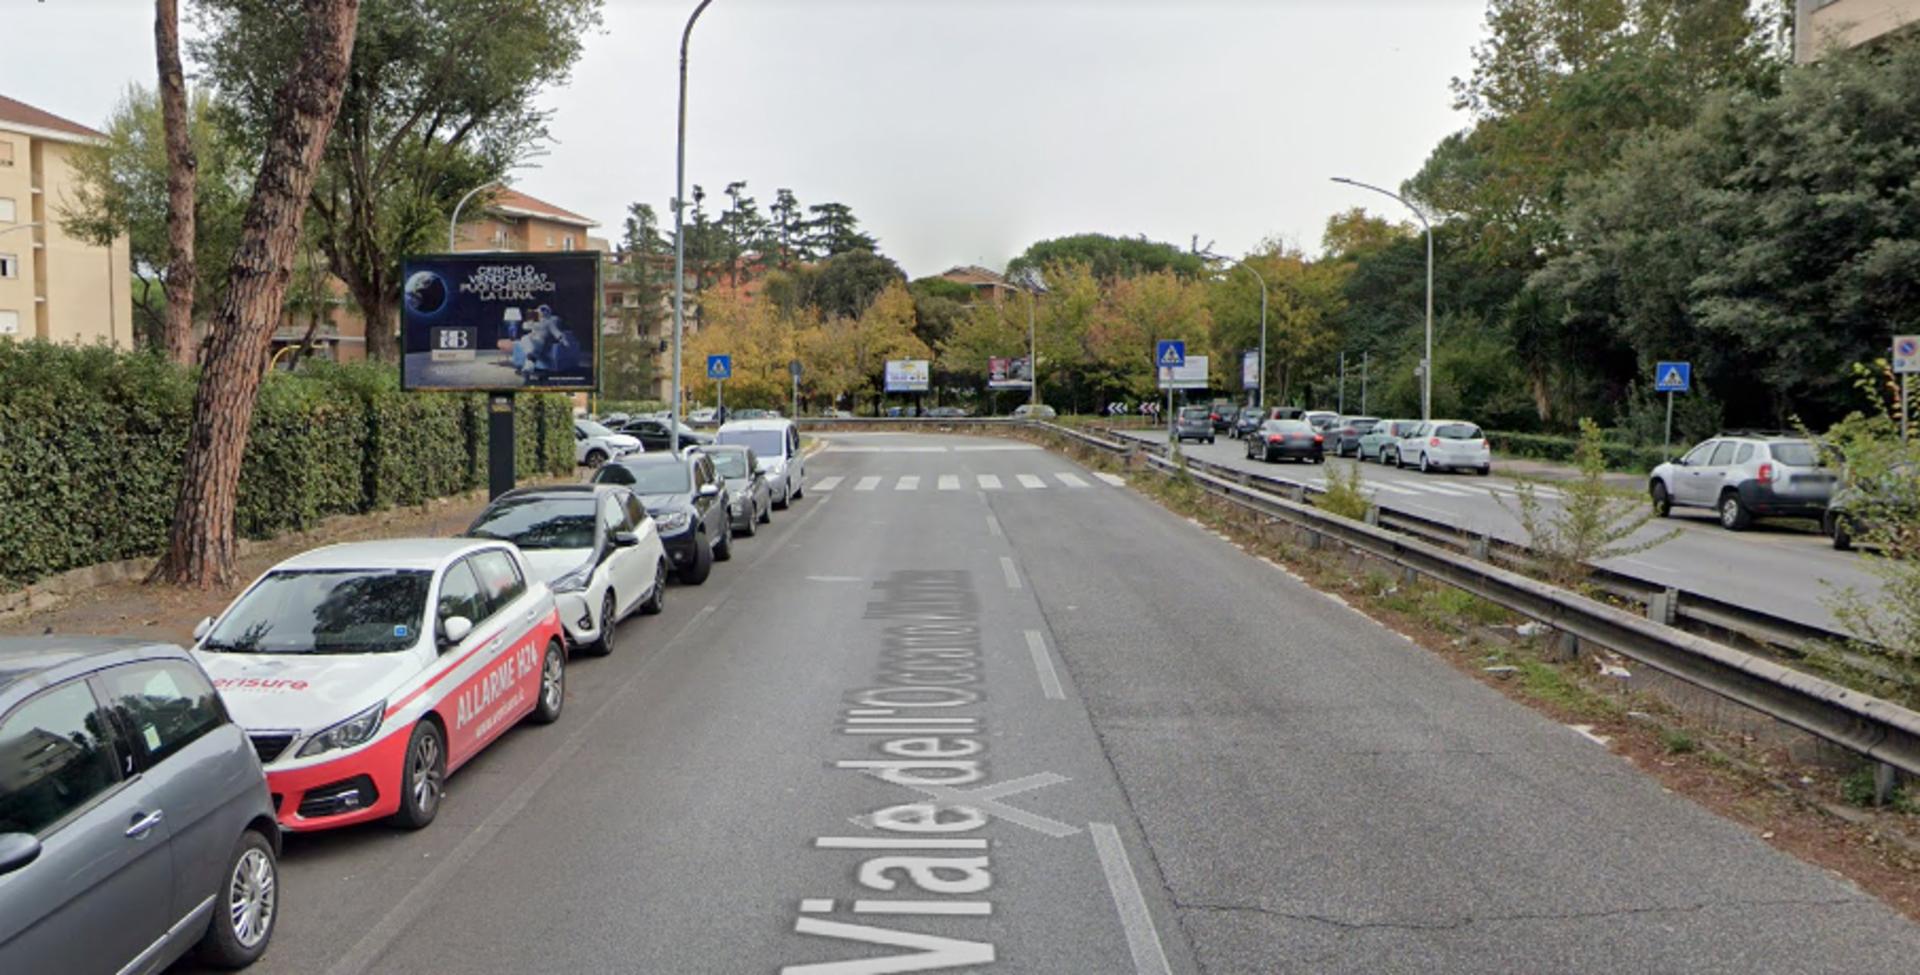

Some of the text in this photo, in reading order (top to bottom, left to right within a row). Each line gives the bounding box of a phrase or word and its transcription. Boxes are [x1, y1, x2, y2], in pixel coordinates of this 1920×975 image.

[477, 264, 535, 275] CERCHI O
[469, 272, 548, 284] VENDI CASA?
[459, 281, 556, 293] PUOI CHIEDERCI
[480, 291, 496, 301] LA
[213, 677, 309, 691] erisure
[456, 640, 538, 730] ALLARME H24
